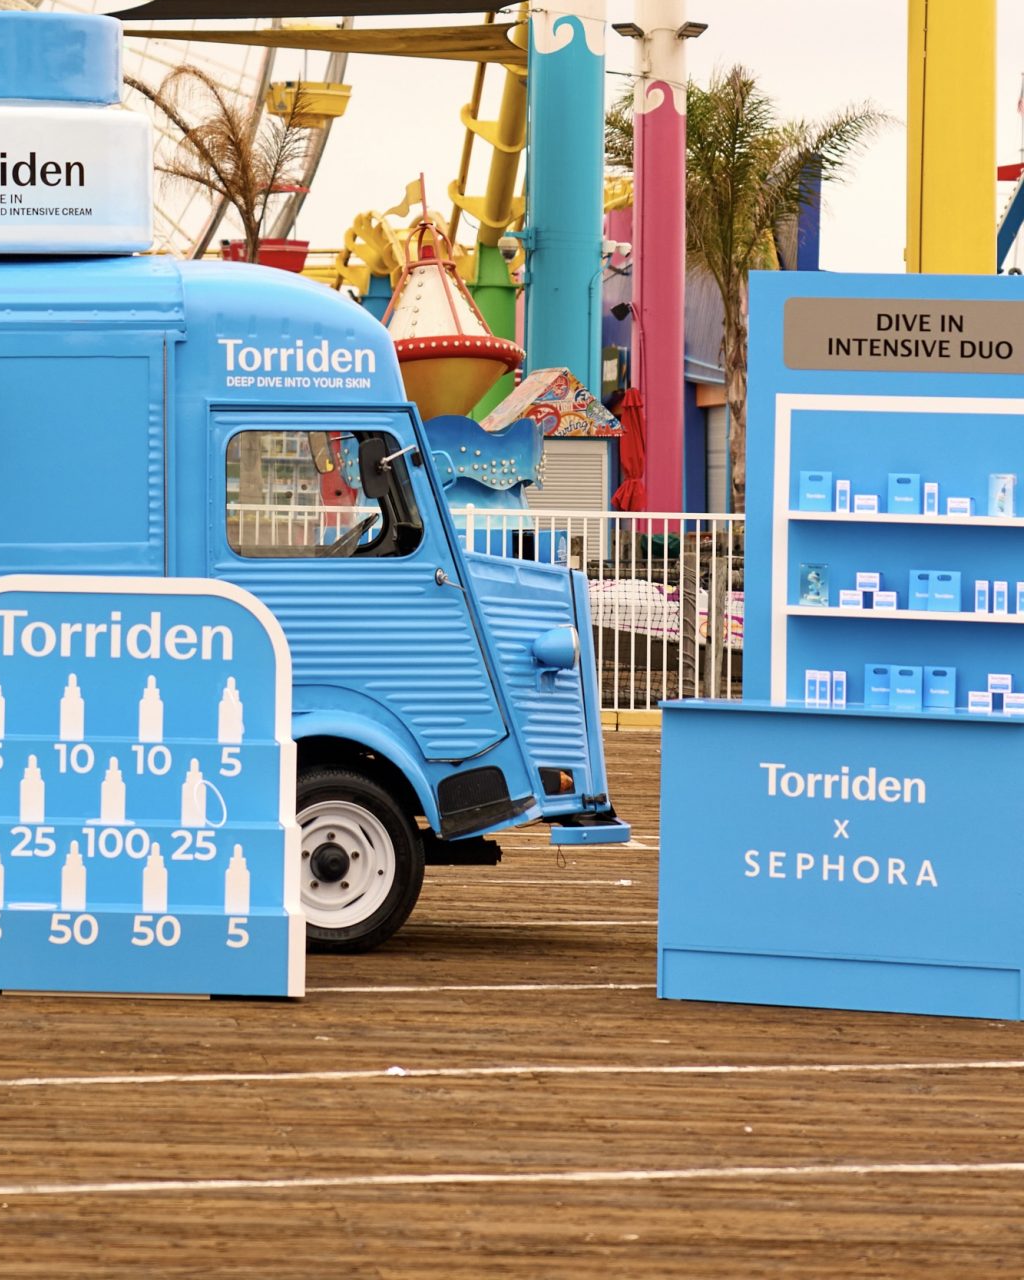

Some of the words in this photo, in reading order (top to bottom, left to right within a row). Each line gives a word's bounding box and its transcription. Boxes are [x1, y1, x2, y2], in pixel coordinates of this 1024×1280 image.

[9, 207, 60, 216] INTENSIVE
[61, 207, 93, 216] CREAM
[10, 194, 23, 204] IN
[876, 313, 932, 333] DIVE
[940, 314, 964, 334] IN
[217, 338, 376, 374] Torriden
[827, 338, 951, 359] INTENSIVE
[960, 340, 1013, 360] DUO
[226, 375, 256, 388] DEEP
[257, 376, 283, 388] DIVE
[284, 376, 311, 388] INTO
[312, 377, 344, 389] YOUR
[345, 377, 371, 389] SKIN
[53, 743, 95, 774] 10
[131, 744, 173, 776] 10
[219, 747, 242, 778] 5
[759, 762, 926, 804] Torriden
[9, 826, 57, 858] 25
[82, 827, 150, 859] 100
[170, 830, 218, 862] 25
[744, 849, 939, 888] SEPHORA
[48, 914, 99, 946] 50
[130, 915, 182, 947] 50
[225, 917, 250, 949] 5
